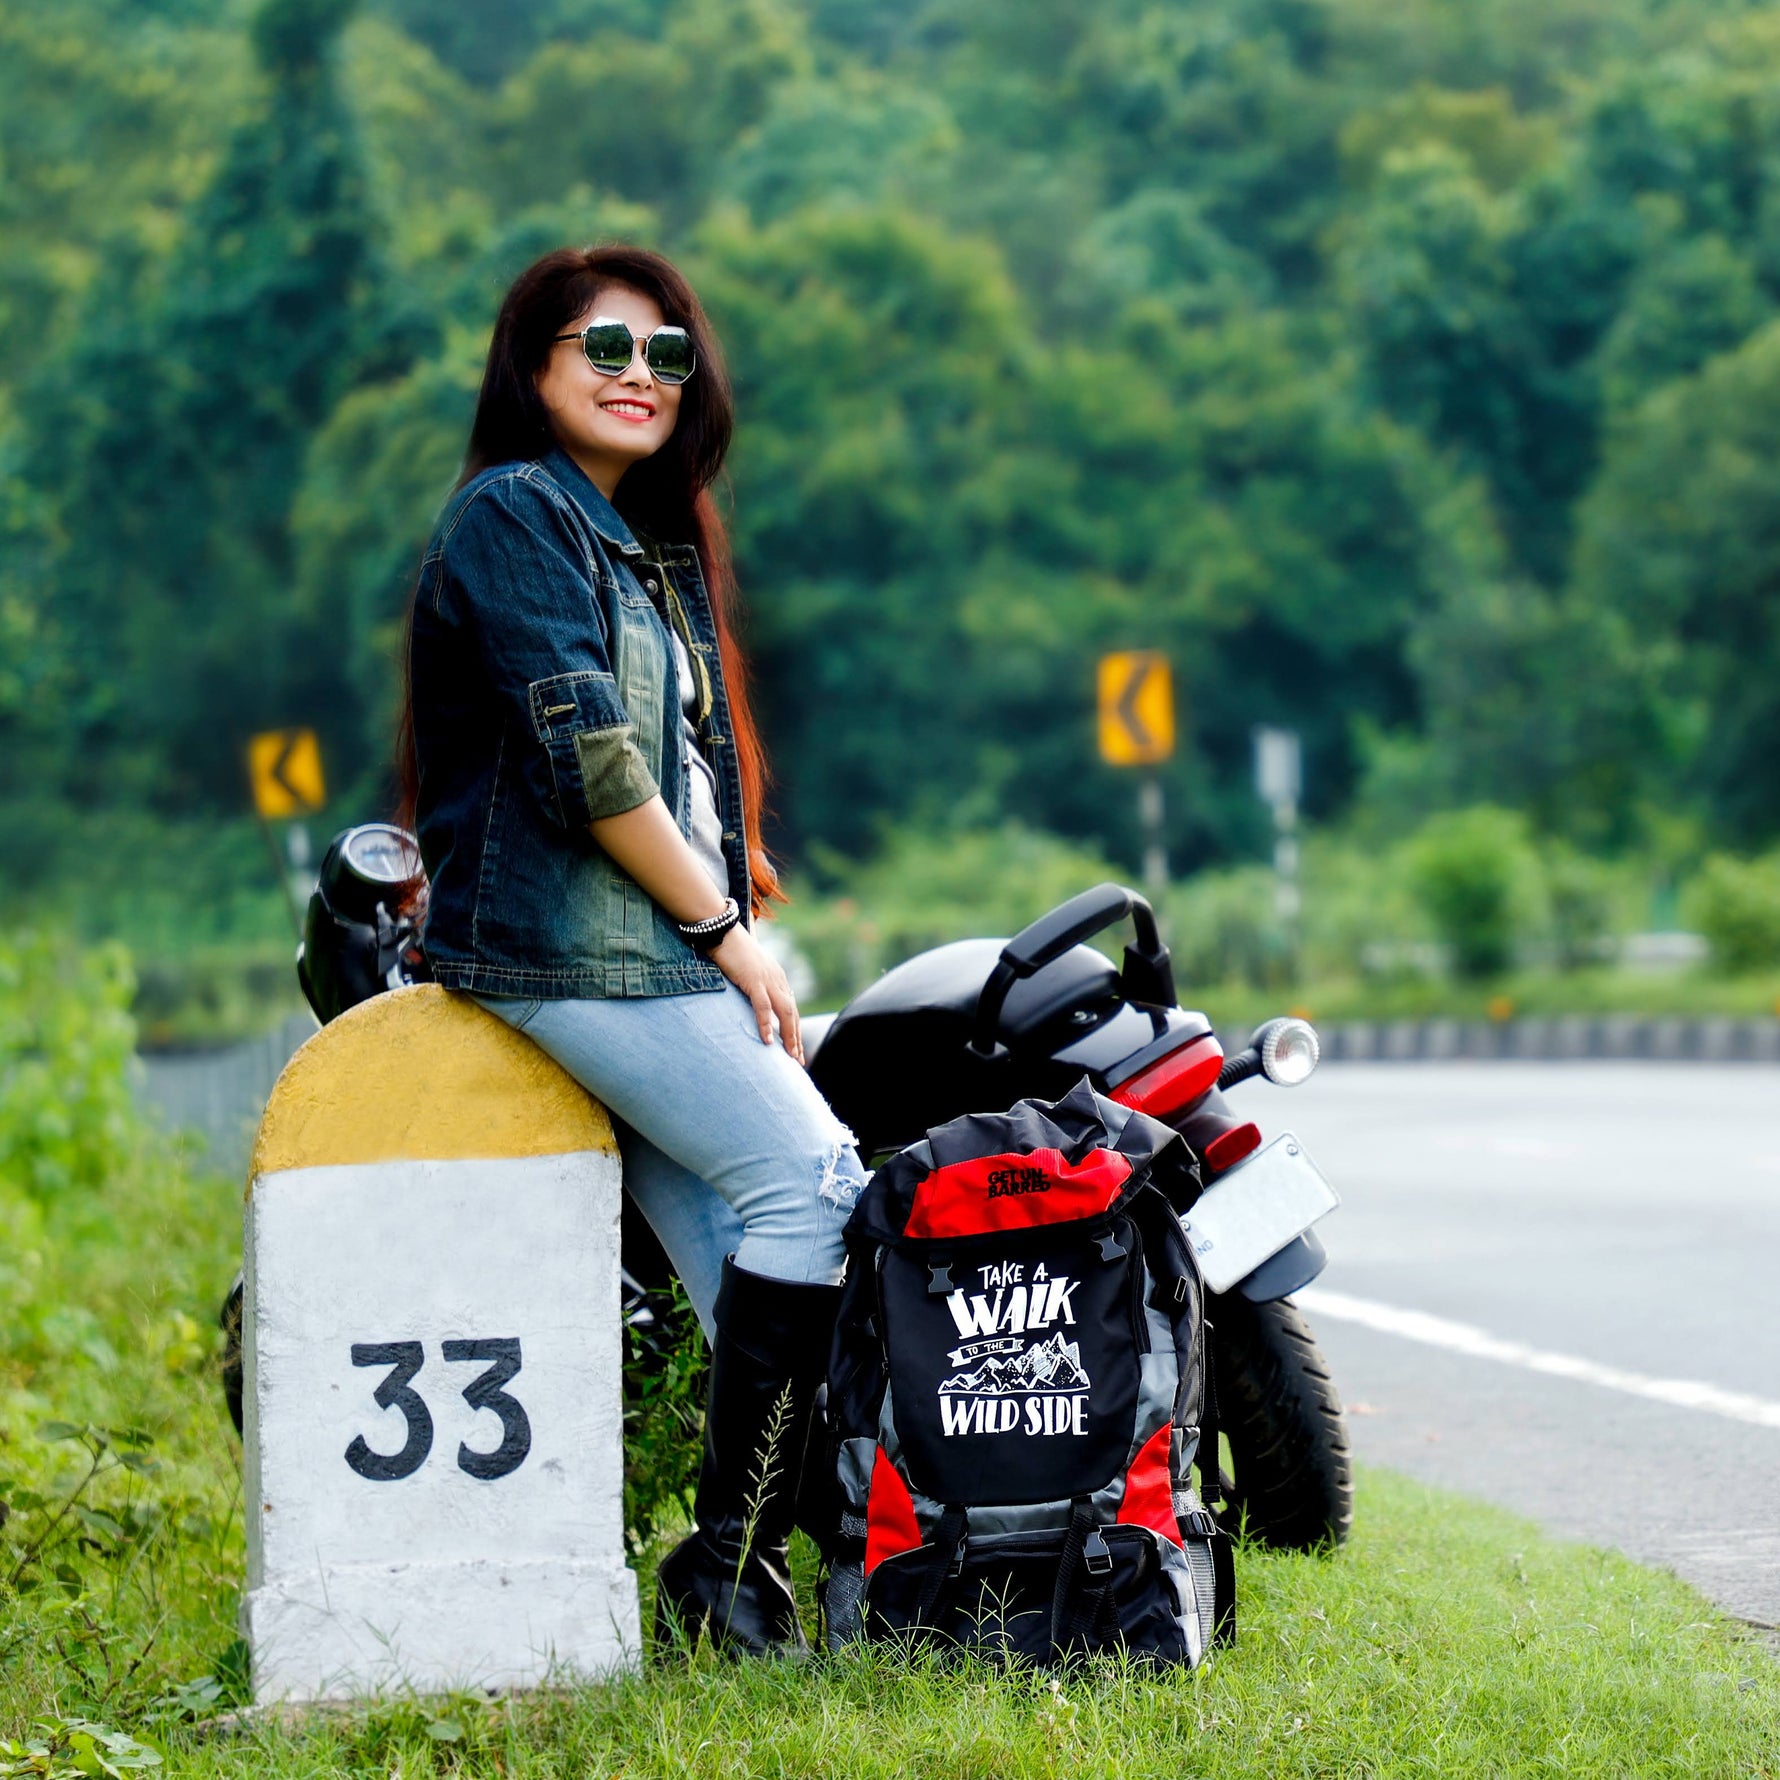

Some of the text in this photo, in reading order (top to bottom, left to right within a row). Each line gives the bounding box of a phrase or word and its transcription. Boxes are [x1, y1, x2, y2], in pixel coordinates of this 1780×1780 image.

[988, 1167, 1048, 1184] GET UN-
[988, 1181, 1051, 1198] BARRED
[977, 1260, 1048, 1289] TAKE A
[946, 1276, 1081, 1339] WALK
[965, 1340, 1005, 1356] TO THE
[344, 1337, 532, 1481] 33
[939, 1394, 1090, 1437] WILD SIDE
